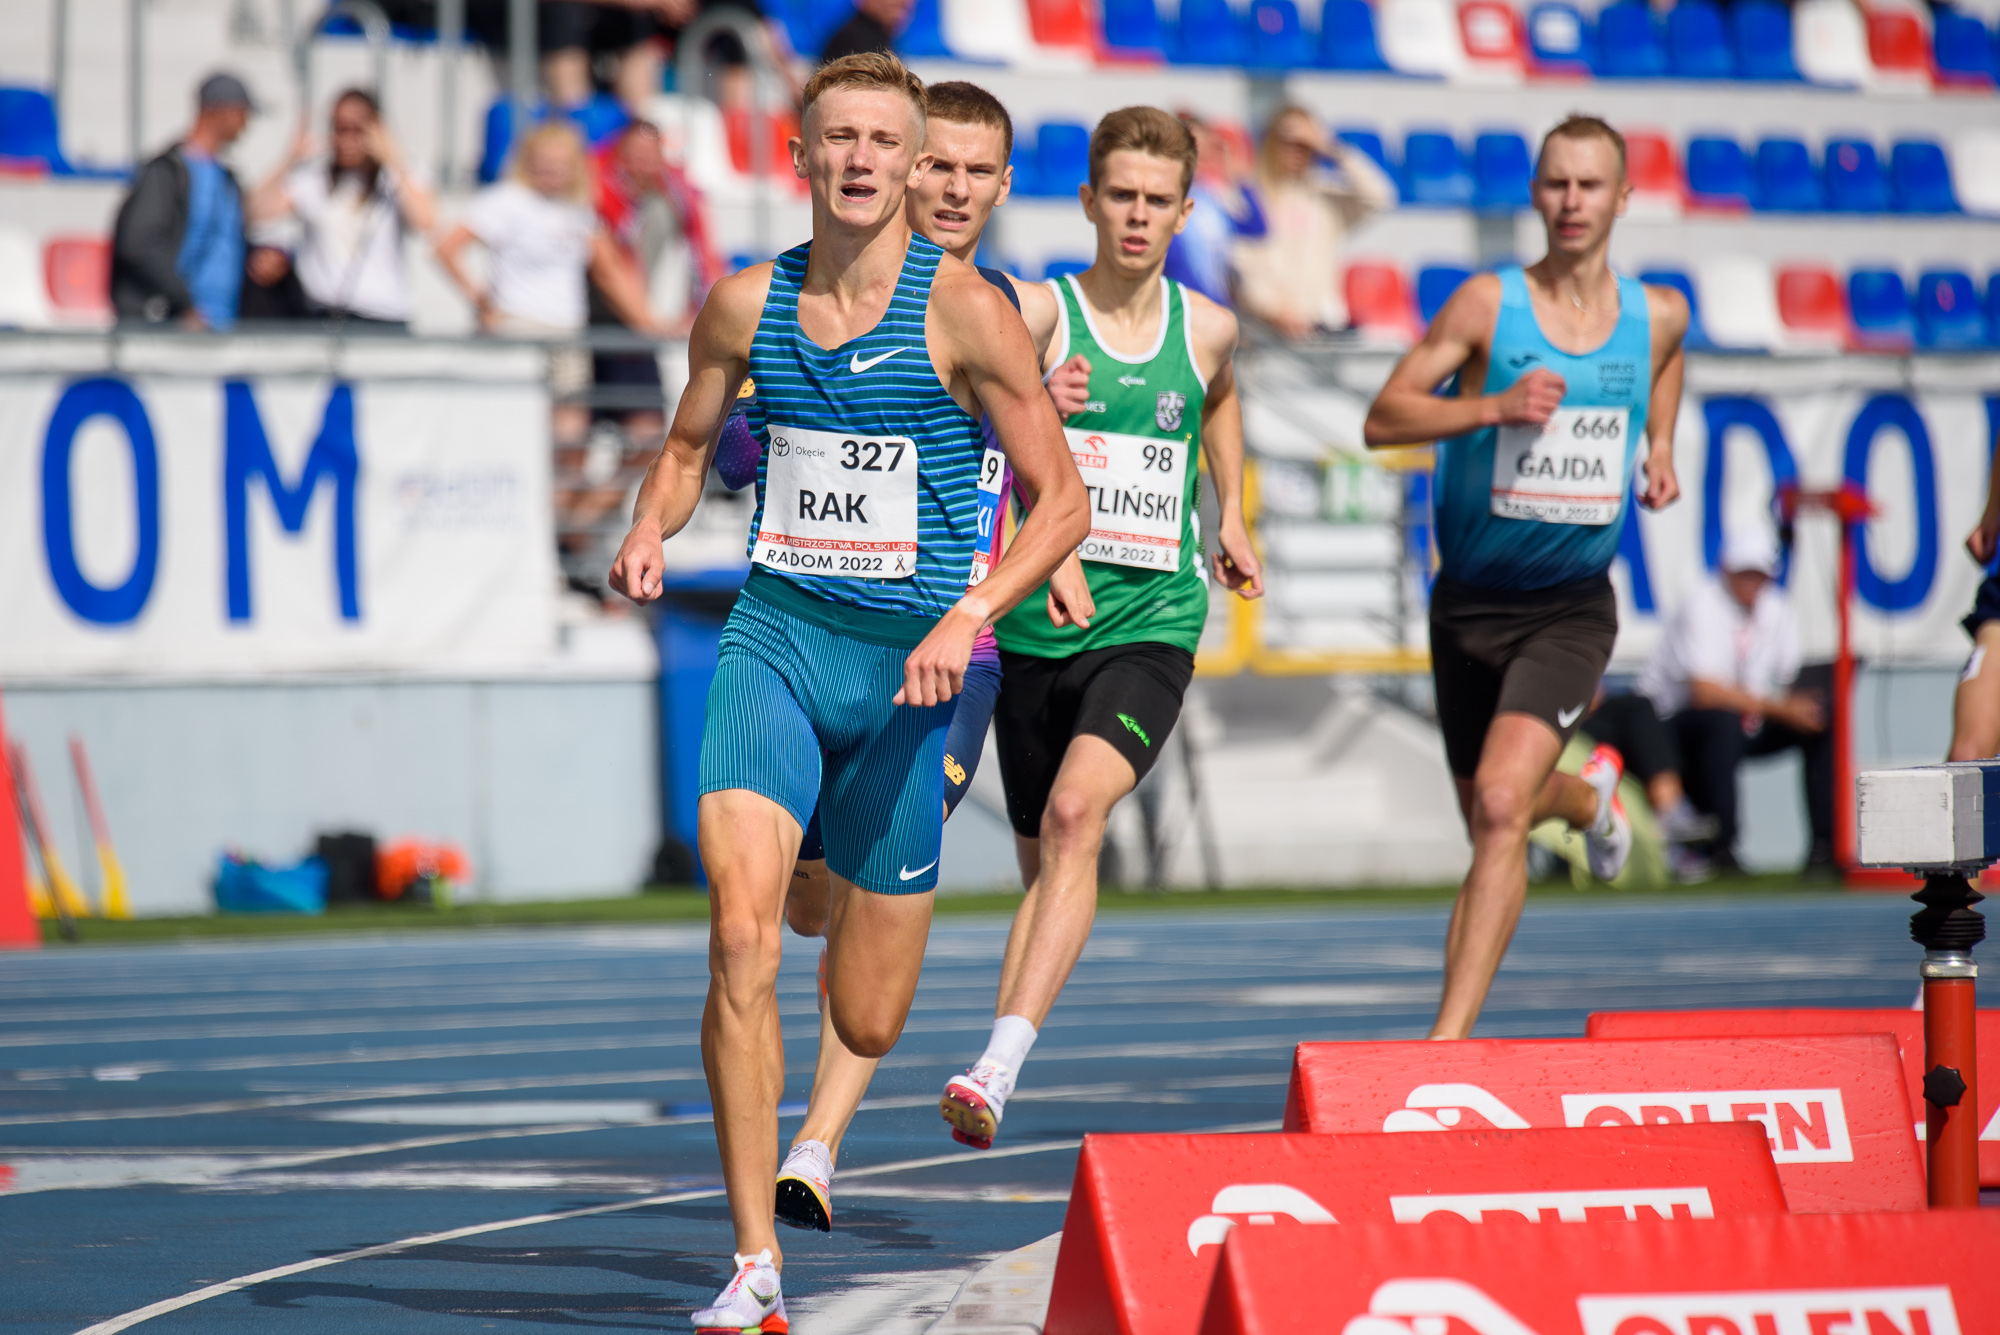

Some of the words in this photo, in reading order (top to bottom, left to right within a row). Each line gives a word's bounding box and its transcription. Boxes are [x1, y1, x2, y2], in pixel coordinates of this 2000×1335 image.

[1573, 416, 1620, 440] 666
[795, 446, 826, 458] Okęcie
[840, 440, 906, 472] 327
[1072, 453, 1104, 468] RLEN
[1142, 444, 1173, 472] 98
[978, 457, 998, 484] 9
[1517, 453, 1606, 481] GAJDA
[799, 489, 868, 524] RAK
[762, 533, 785, 544] PZLA
[787, 536, 852, 550] MISTRZOSTWA
[854, 542, 890, 551] POLSKI
[892, 542, 913, 551] U20
[766, 549, 833, 569] RADOM
[839, 556, 882, 571] 2022
[1120, 547, 1155, 562] 2022
